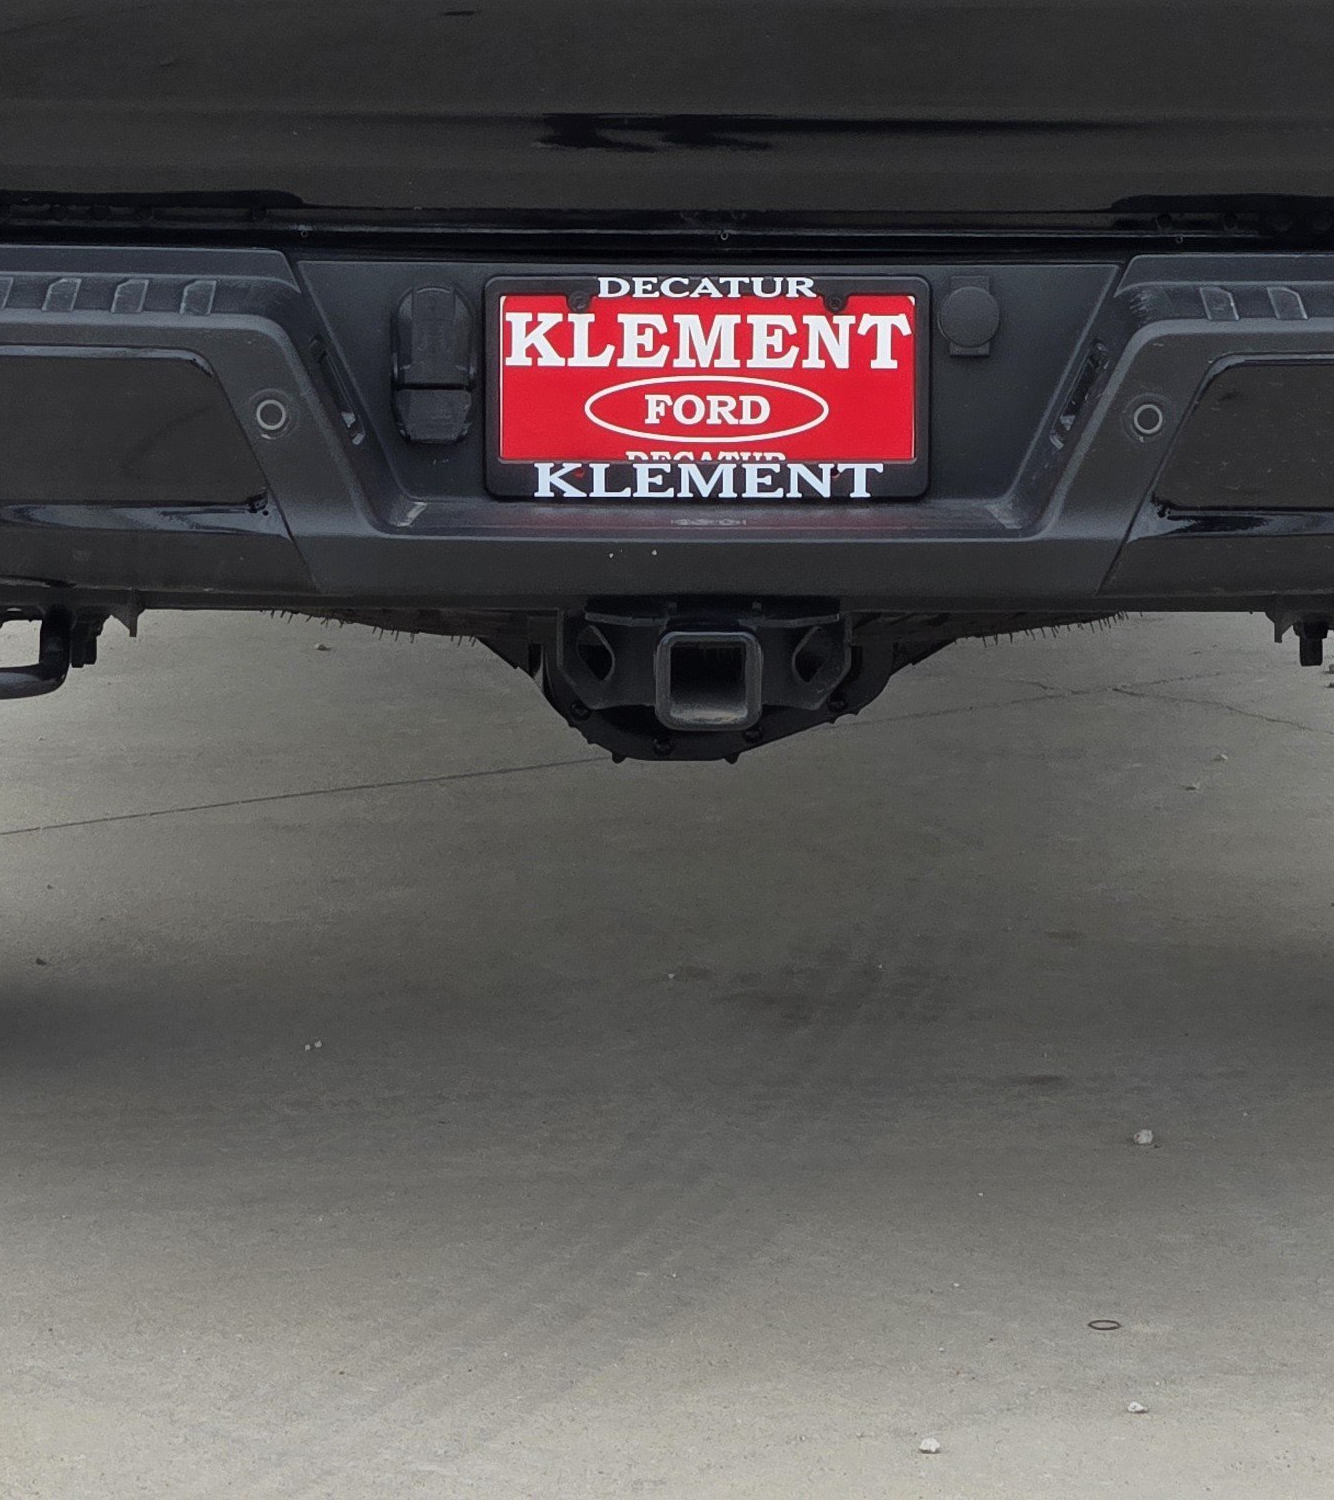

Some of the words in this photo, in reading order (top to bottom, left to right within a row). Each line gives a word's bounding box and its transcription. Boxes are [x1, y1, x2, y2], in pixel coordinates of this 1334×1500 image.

[597, 276, 816, 298] DECATUR
[504, 312, 912, 370] KLEMENT
[644, 394, 771, 426] FORD
[533, 463, 884, 499] KLEMENT
